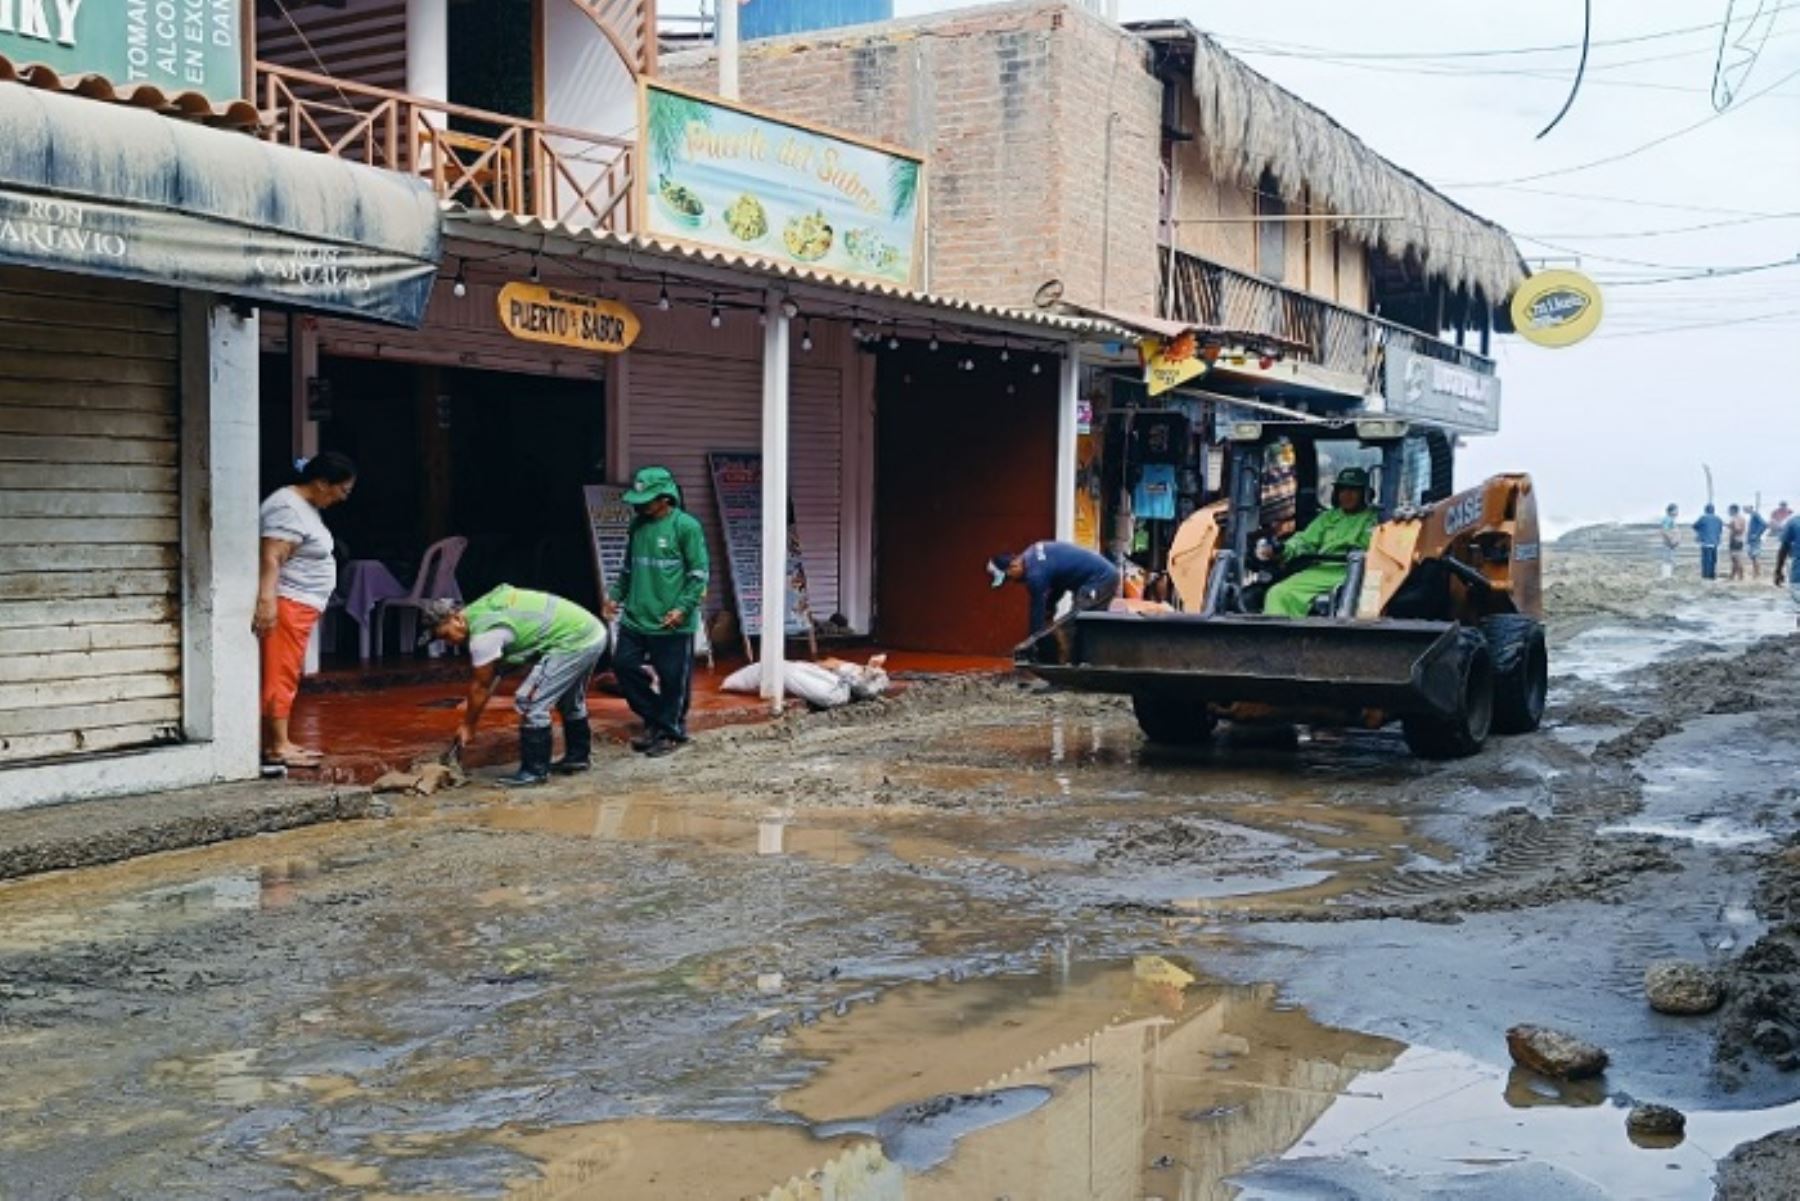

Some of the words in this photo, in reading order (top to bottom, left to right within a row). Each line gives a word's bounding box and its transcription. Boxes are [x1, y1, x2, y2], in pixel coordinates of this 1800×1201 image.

[127, 0, 149, 80] TOMA
[155, 0, 178, 77] ALCO
[184, 47, 205, 84] EN
[29, 199, 82, 224] RON
[0, 218, 126, 258] ARTAVIO
[510, 298, 569, 337] PUERTO
[582, 310, 625, 347] SABOR
[1444, 496, 1483, 535] CASE
